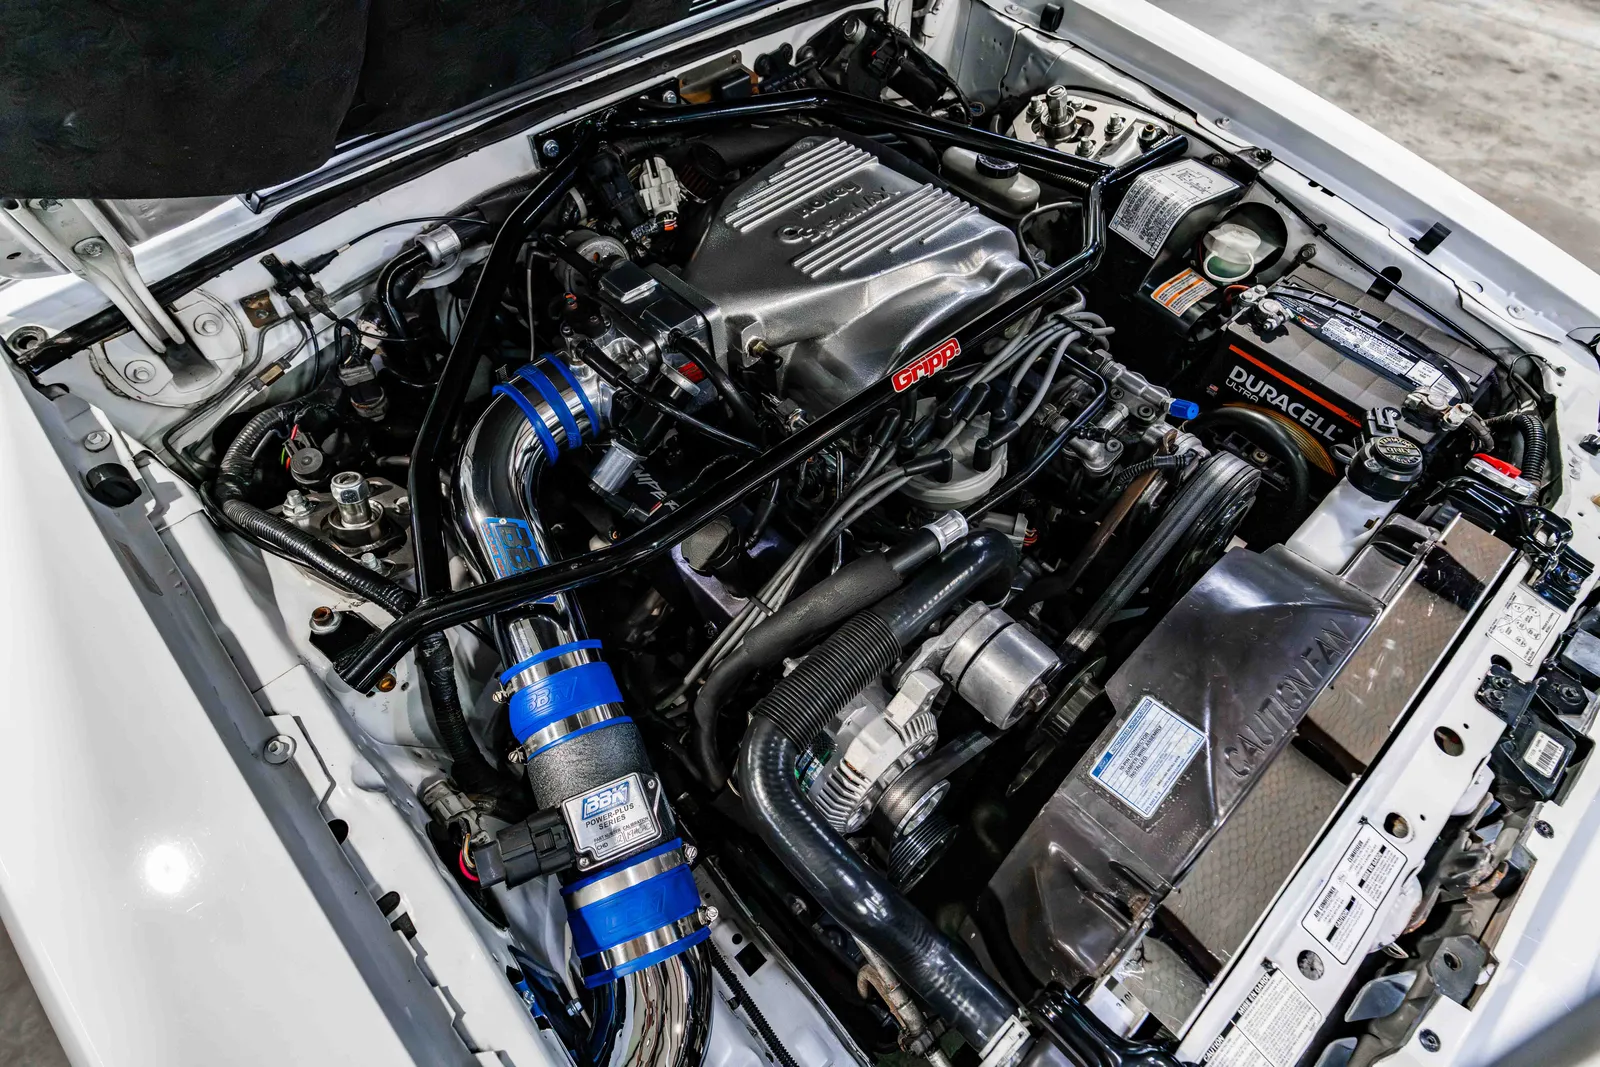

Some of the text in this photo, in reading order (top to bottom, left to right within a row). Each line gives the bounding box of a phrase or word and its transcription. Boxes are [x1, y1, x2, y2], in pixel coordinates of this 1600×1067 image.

[893, 340, 960, 391] Gripp!
[1225, 378, 1260, 403] ULTRA
[1228, 365, 1339, 442] DURACELL
[1222, 618, 1352, 779] CAUTION FAN
[1124, 756, 1139, 775] JUMPER
[1145, 725, 1162, 747] ASSEMBLY
[1128, 731, 1149, 758] CONNECTOR
[1129, 755, 1148, 779] INSTALLED
[583, 784, 630, 817] BBK
[598, 814, 627, 831] SERIES
[1203, 1035, 1225, 1063] CAUTION
